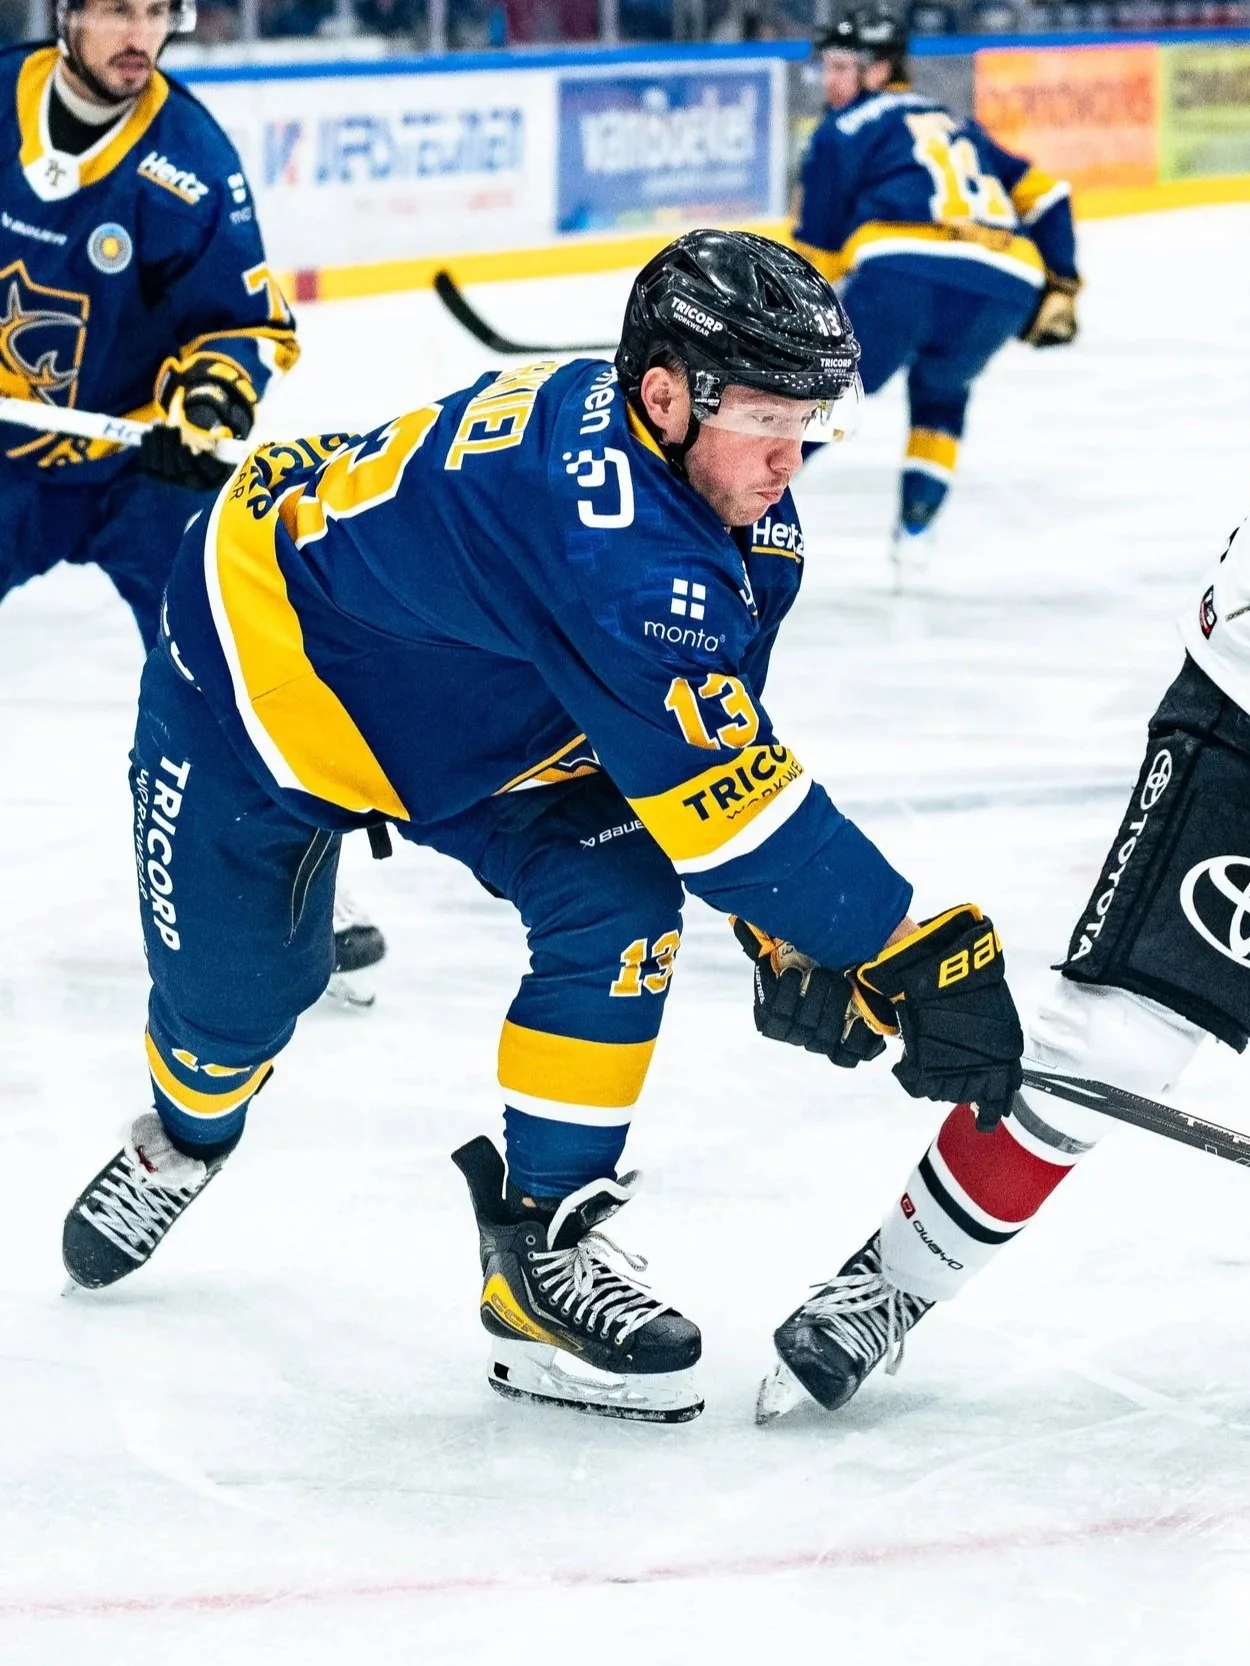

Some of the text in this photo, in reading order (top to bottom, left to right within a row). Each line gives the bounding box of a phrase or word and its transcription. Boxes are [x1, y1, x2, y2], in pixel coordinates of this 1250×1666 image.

[139, 151, 209, 204] Hertz
[670, 296, 726, 333] TRICORP
[672, 311, 711, 338] WORKWEAR
[812, 311, 842, 347] 13
[820, 357, 852, 368] TRICORP
[663, 672, 760, 750] 13
[147, 755, 191, 951] TRICORP
[1070, 813, 1149, 961] TOYOTA
[609, 929, 682, 998] 13
[912, 1219, 964, 1271] owayo
